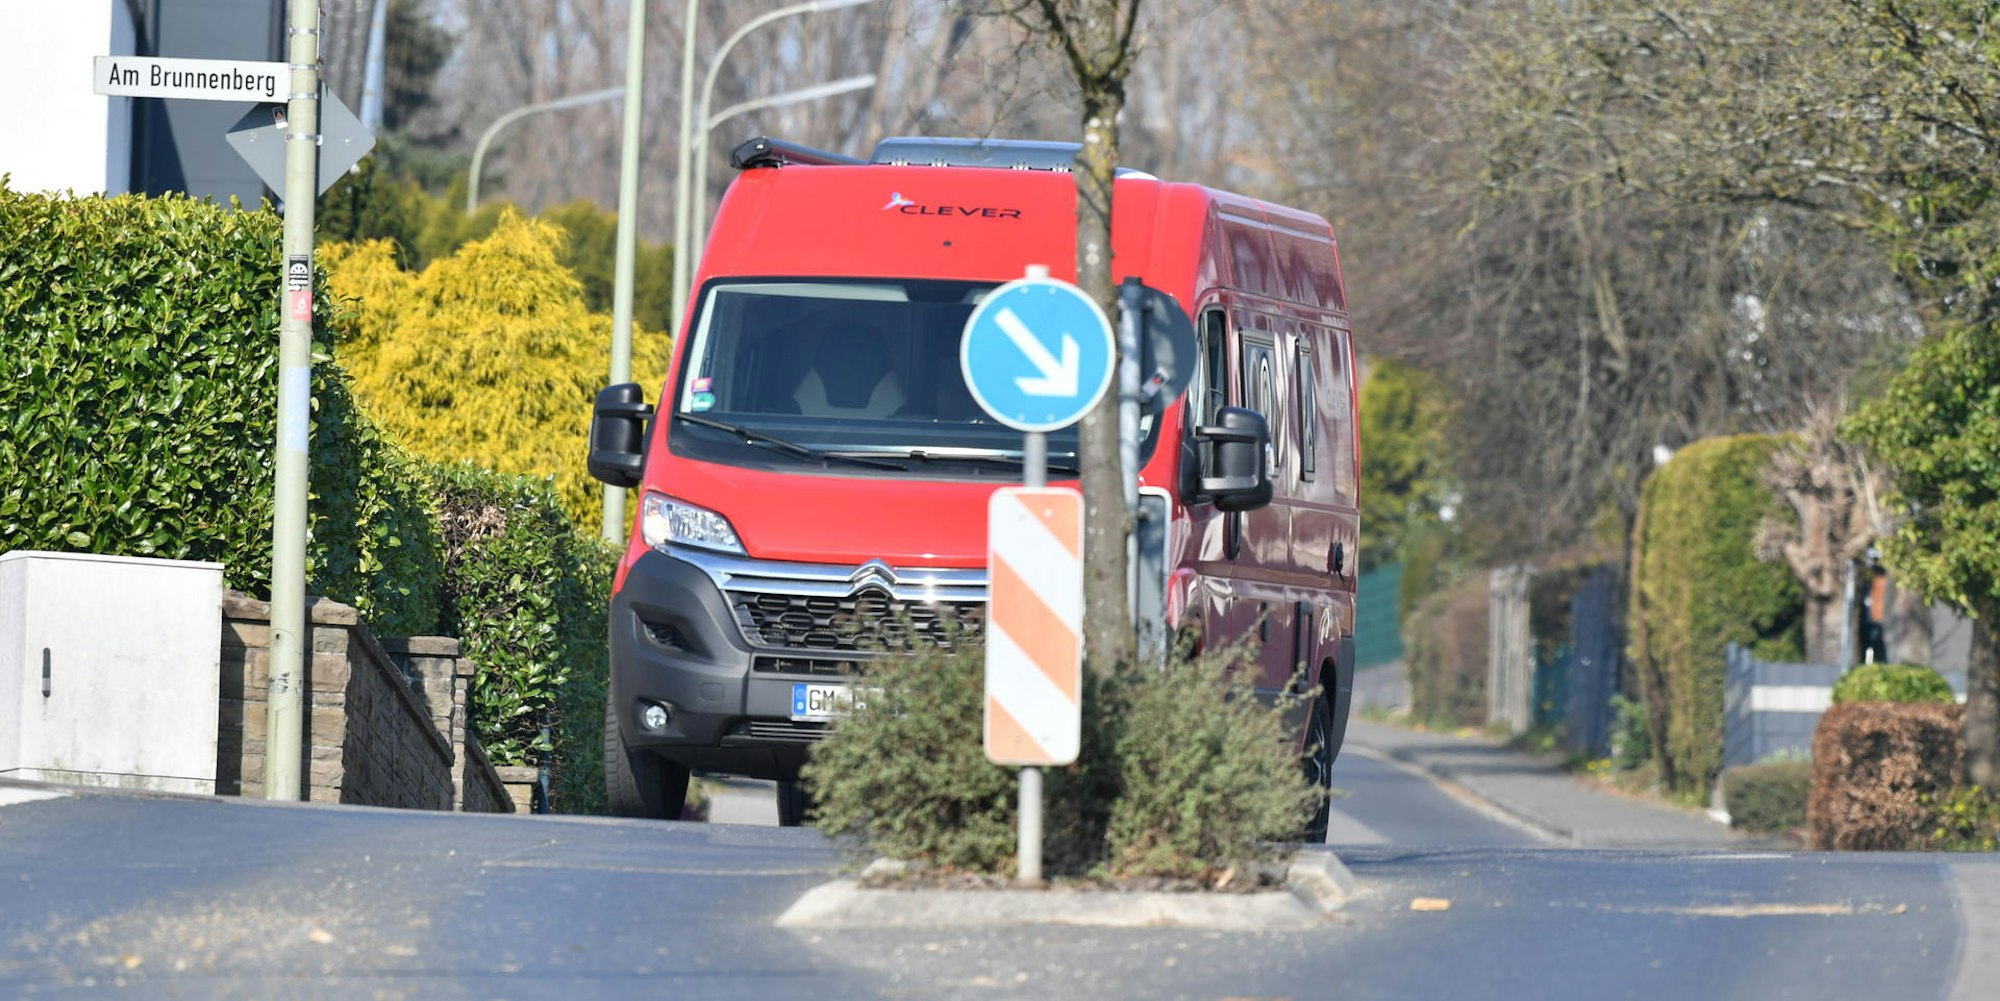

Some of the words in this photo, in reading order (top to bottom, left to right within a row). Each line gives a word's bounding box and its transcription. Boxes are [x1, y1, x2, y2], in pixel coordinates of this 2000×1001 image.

[109, 62, 139, 86] Am
[150, 64, 276, 97] Brunnenberg
[900, 204, 1022, 218] CLEVER
